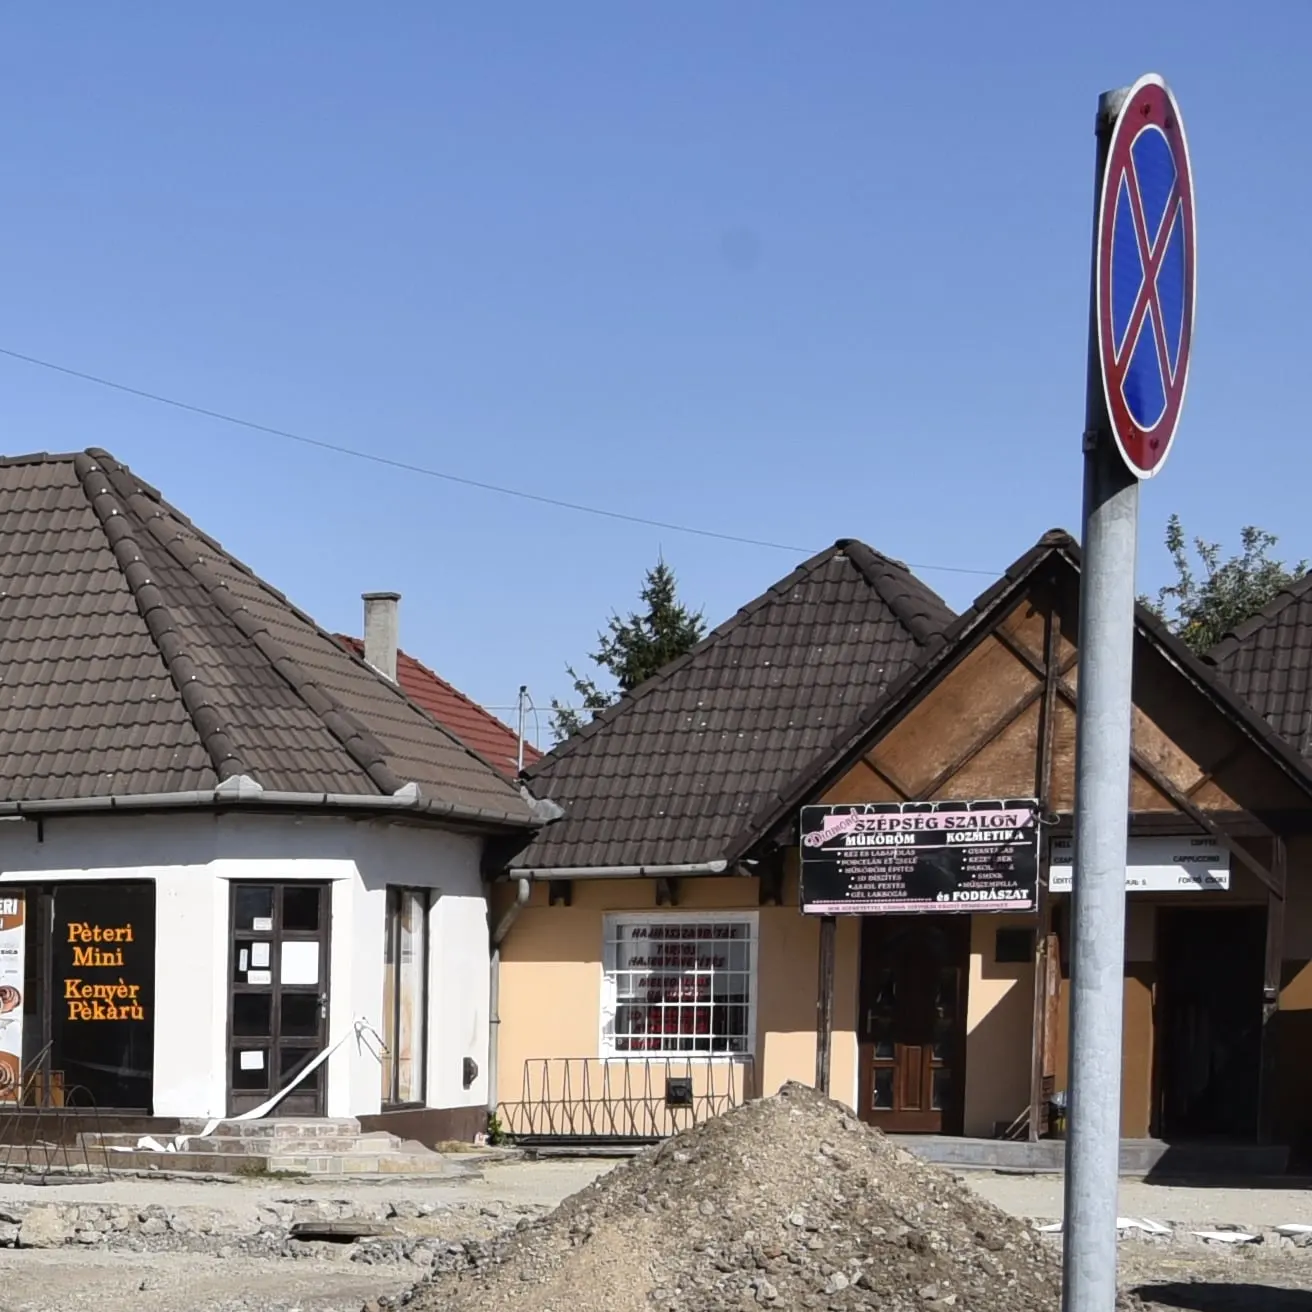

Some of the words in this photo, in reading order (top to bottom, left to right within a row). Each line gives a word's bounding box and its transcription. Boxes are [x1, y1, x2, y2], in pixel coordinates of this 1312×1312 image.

[854, 814, 938, 832] SZÉPSÉG
[944, 814, 1018, 829] SZALON
[936, 891, 950, 902] és
[952, 887, 1029, 901] FODRÁSZAT
[72, 946, 124, 966] Mini
